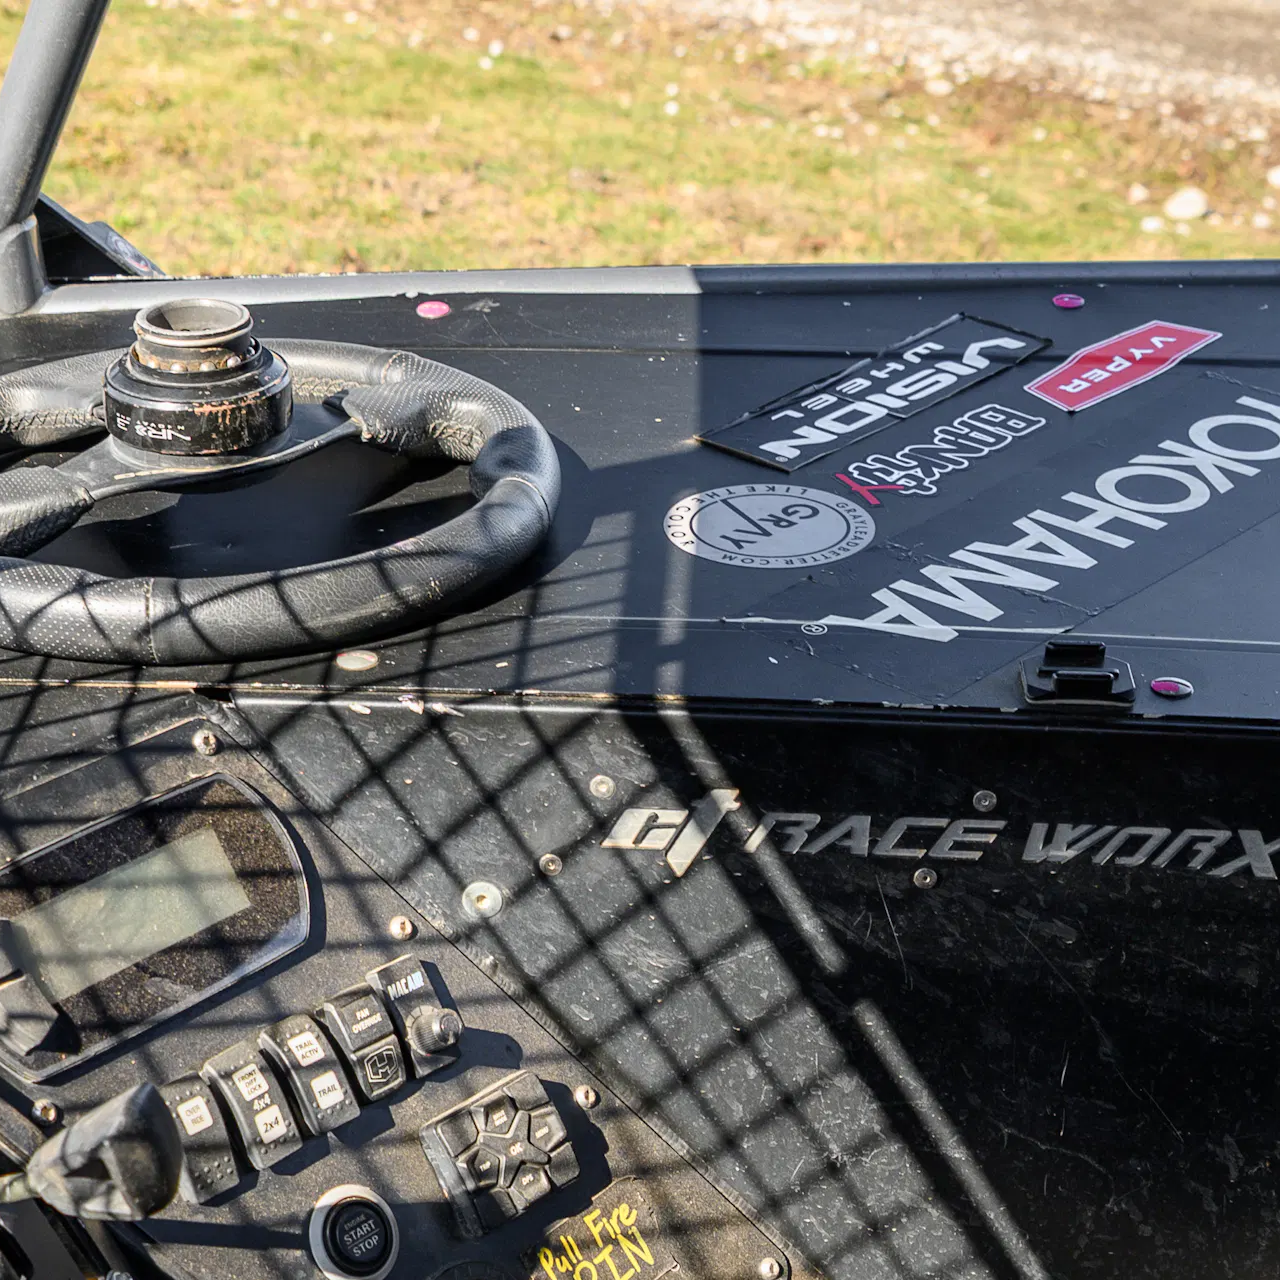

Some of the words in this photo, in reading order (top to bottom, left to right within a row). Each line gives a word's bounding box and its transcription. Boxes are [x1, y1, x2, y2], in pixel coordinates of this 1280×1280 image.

[1058, 335, 1177, 394] VYPER
[771, 342, 945, 420] WHEEL
[759, 337, 1027, 459] VISION
[691, 487, 737, 504] THE
[745, 485, 807, 496] LIKE
[668, 505, 695, 547] COLOR
[719, 499, 820, 551] GRAY
[722, 501, 868, 566] GRAYLEADBETTER.COM
[744, 812, 1007, 861] RACE
[356, 1007, 371, 1021] FAN
[295, 1040, 314, 1052] TRAIL
[300, 1048, 319, 1061] ACTIV
[237, 1069, 257, 1083] FRONT
[317, 1084, 338, 1098] TRAIL
[252, 1094, 271, 1111] 4x4
[263, 1117, 281, 1133] 2x4
[510, 1143, 523, 1156] OK
[344, 1213, 367, 1231] ENGINE
[583, 1202, 640, 1249] Fire
[344, 1220, 376, 1245] START
[353, 1234, 379, 1257] STOP
